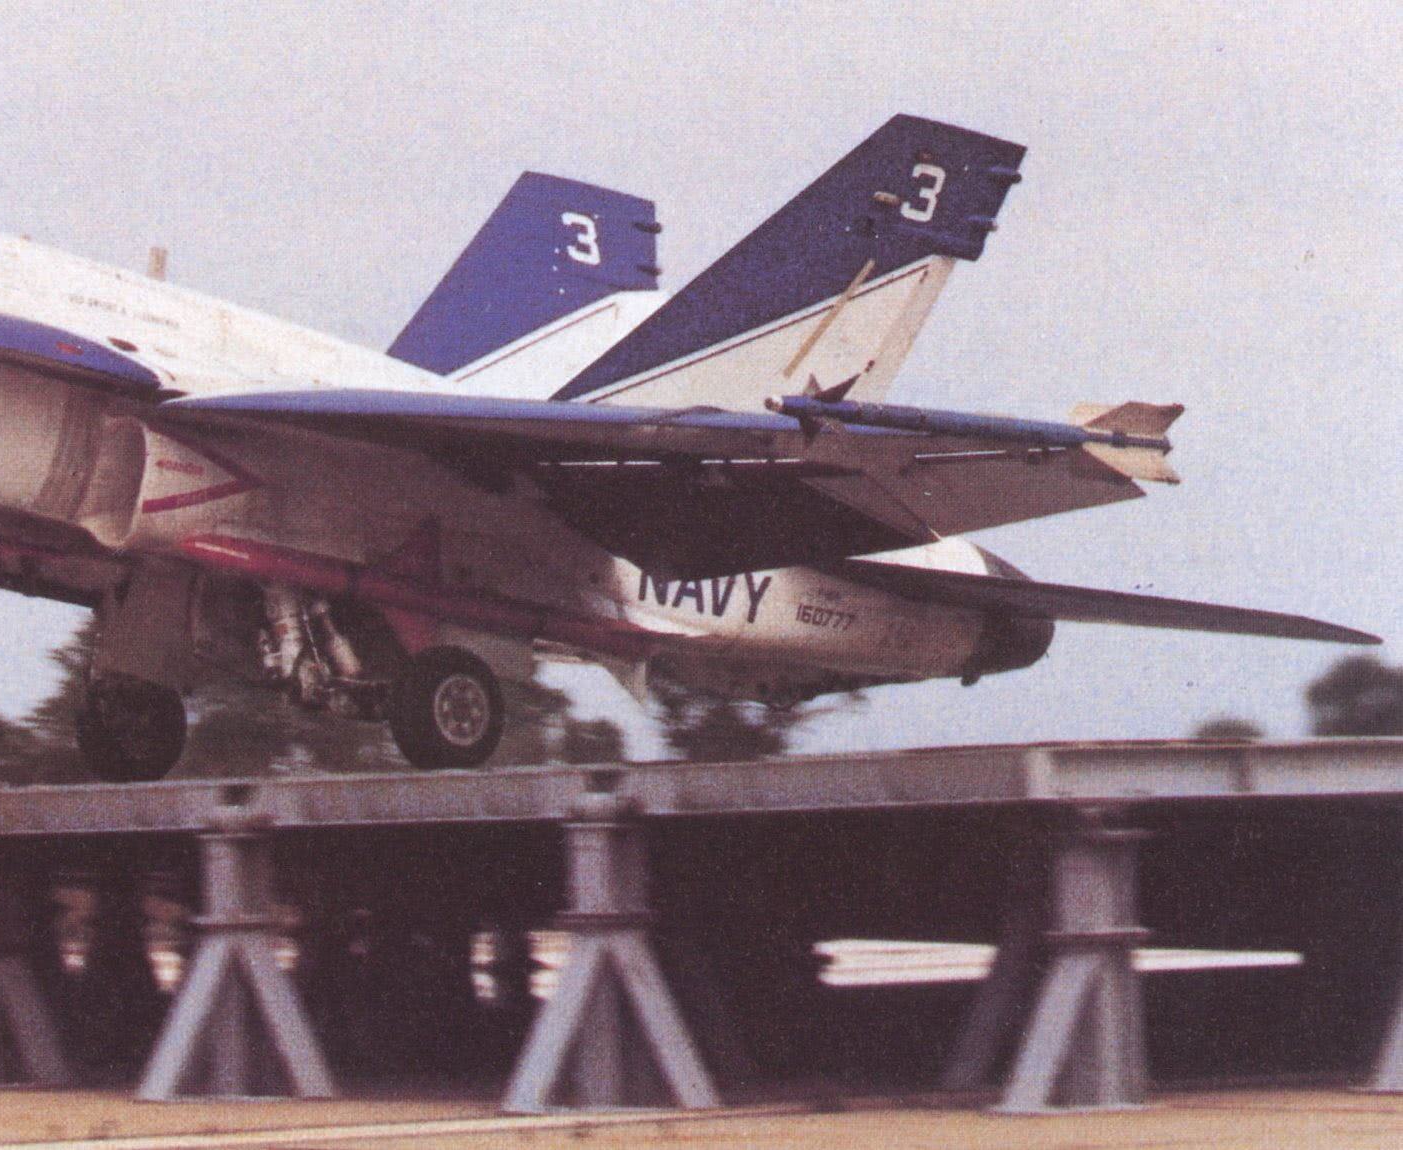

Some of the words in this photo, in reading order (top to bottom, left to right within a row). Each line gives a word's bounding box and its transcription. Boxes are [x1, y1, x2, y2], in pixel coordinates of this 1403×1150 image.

[901, 163, 946, 222] 3
[561, 211, 601, 265] 3
[638, 570, 773, 623] NAVY
[795, 602, 856, 631] 160777
